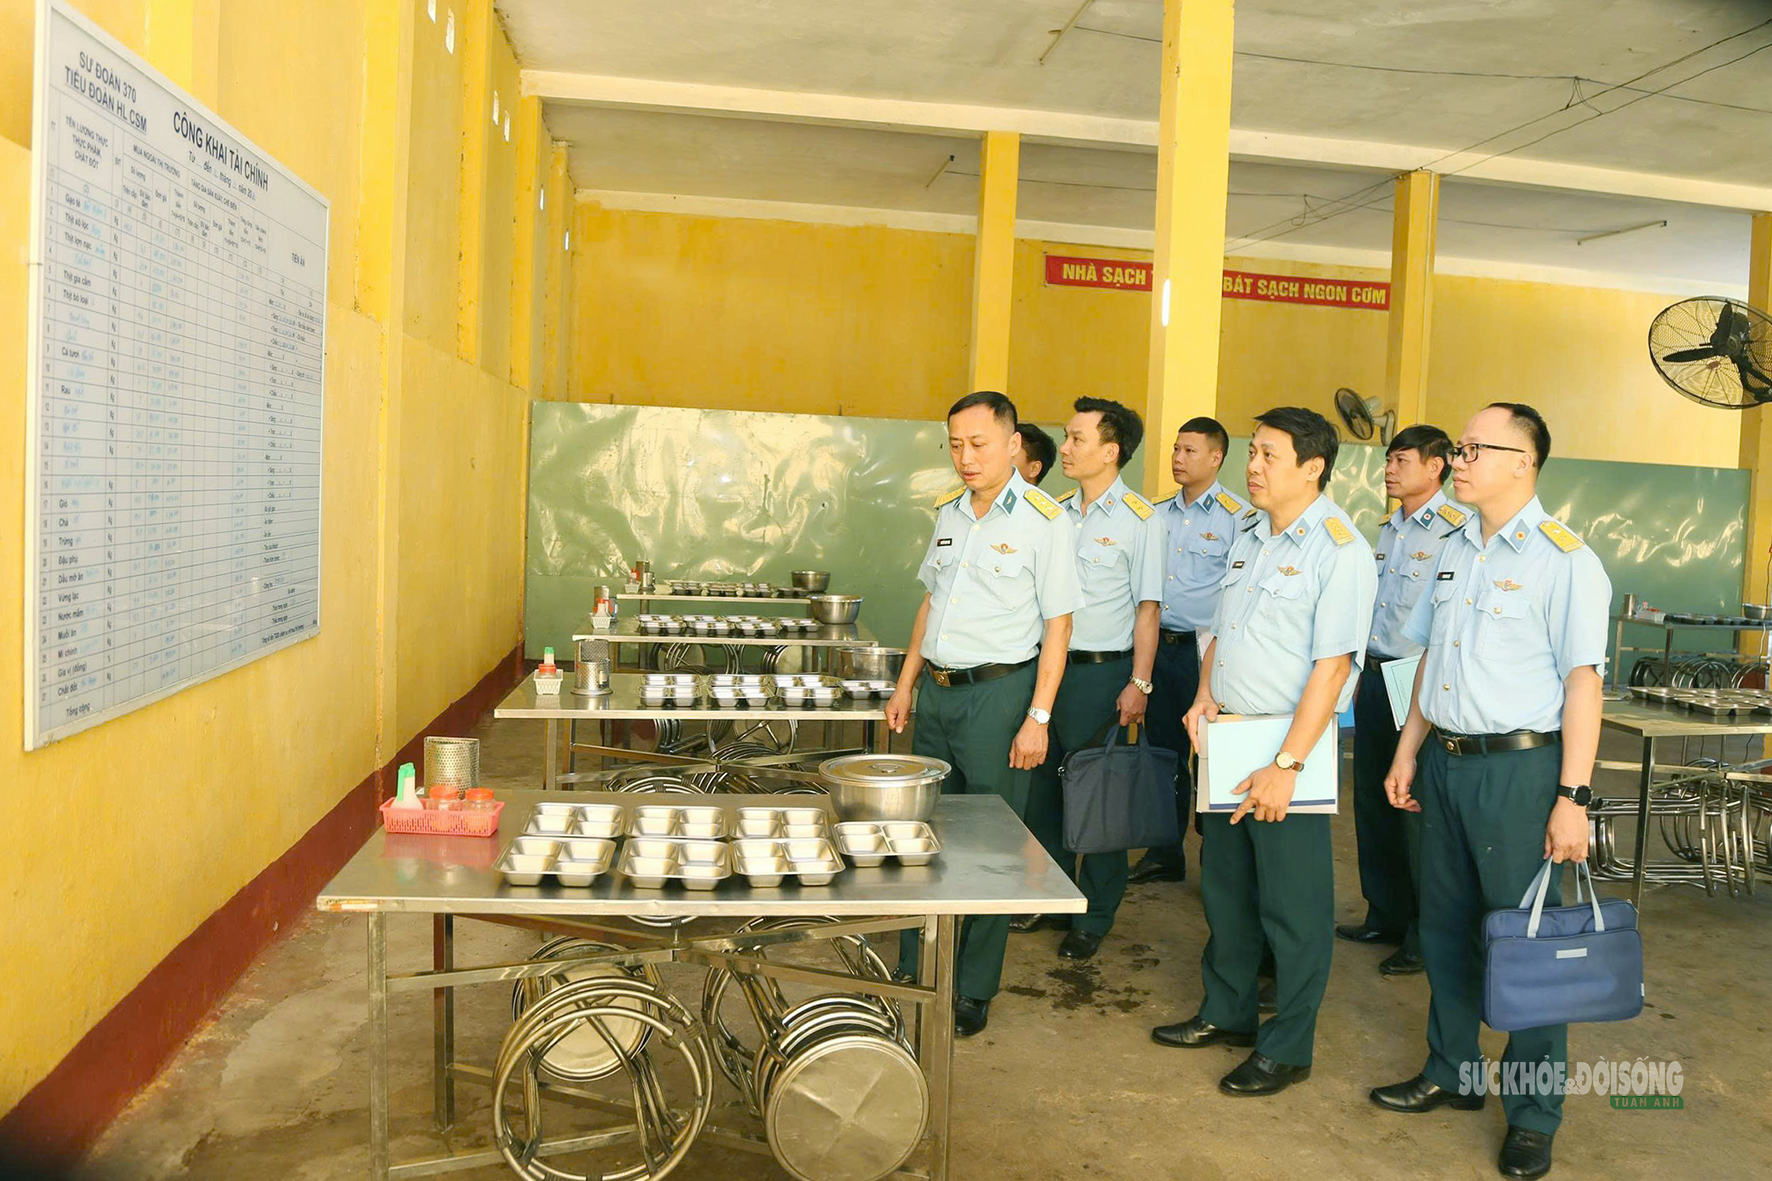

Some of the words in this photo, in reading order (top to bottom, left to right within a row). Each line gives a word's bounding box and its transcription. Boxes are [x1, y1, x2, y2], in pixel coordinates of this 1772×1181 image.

[95, 62, 121, 93] ĐOÀN
[123, 82, 137, 103] 370
[129, 109, 147, 132] CSM
[173, 111, 203, 148] CÔNG
[205, 133, 227, 165] KHAI
[229, 148, 243, 175] TÀI
[244, 161, 268, 192] CHÍNH
[1063, 262, 1097, 281] NHÀ
[1102, 266, 1146, 287] SẠCH
[1223, 275, 1253, 294] BÁT
[1257, 279, 1299, 299] SẠCH
[1303, 283, 1347, 301] NGON
[1351, 286, 1386, 305] CƠM
